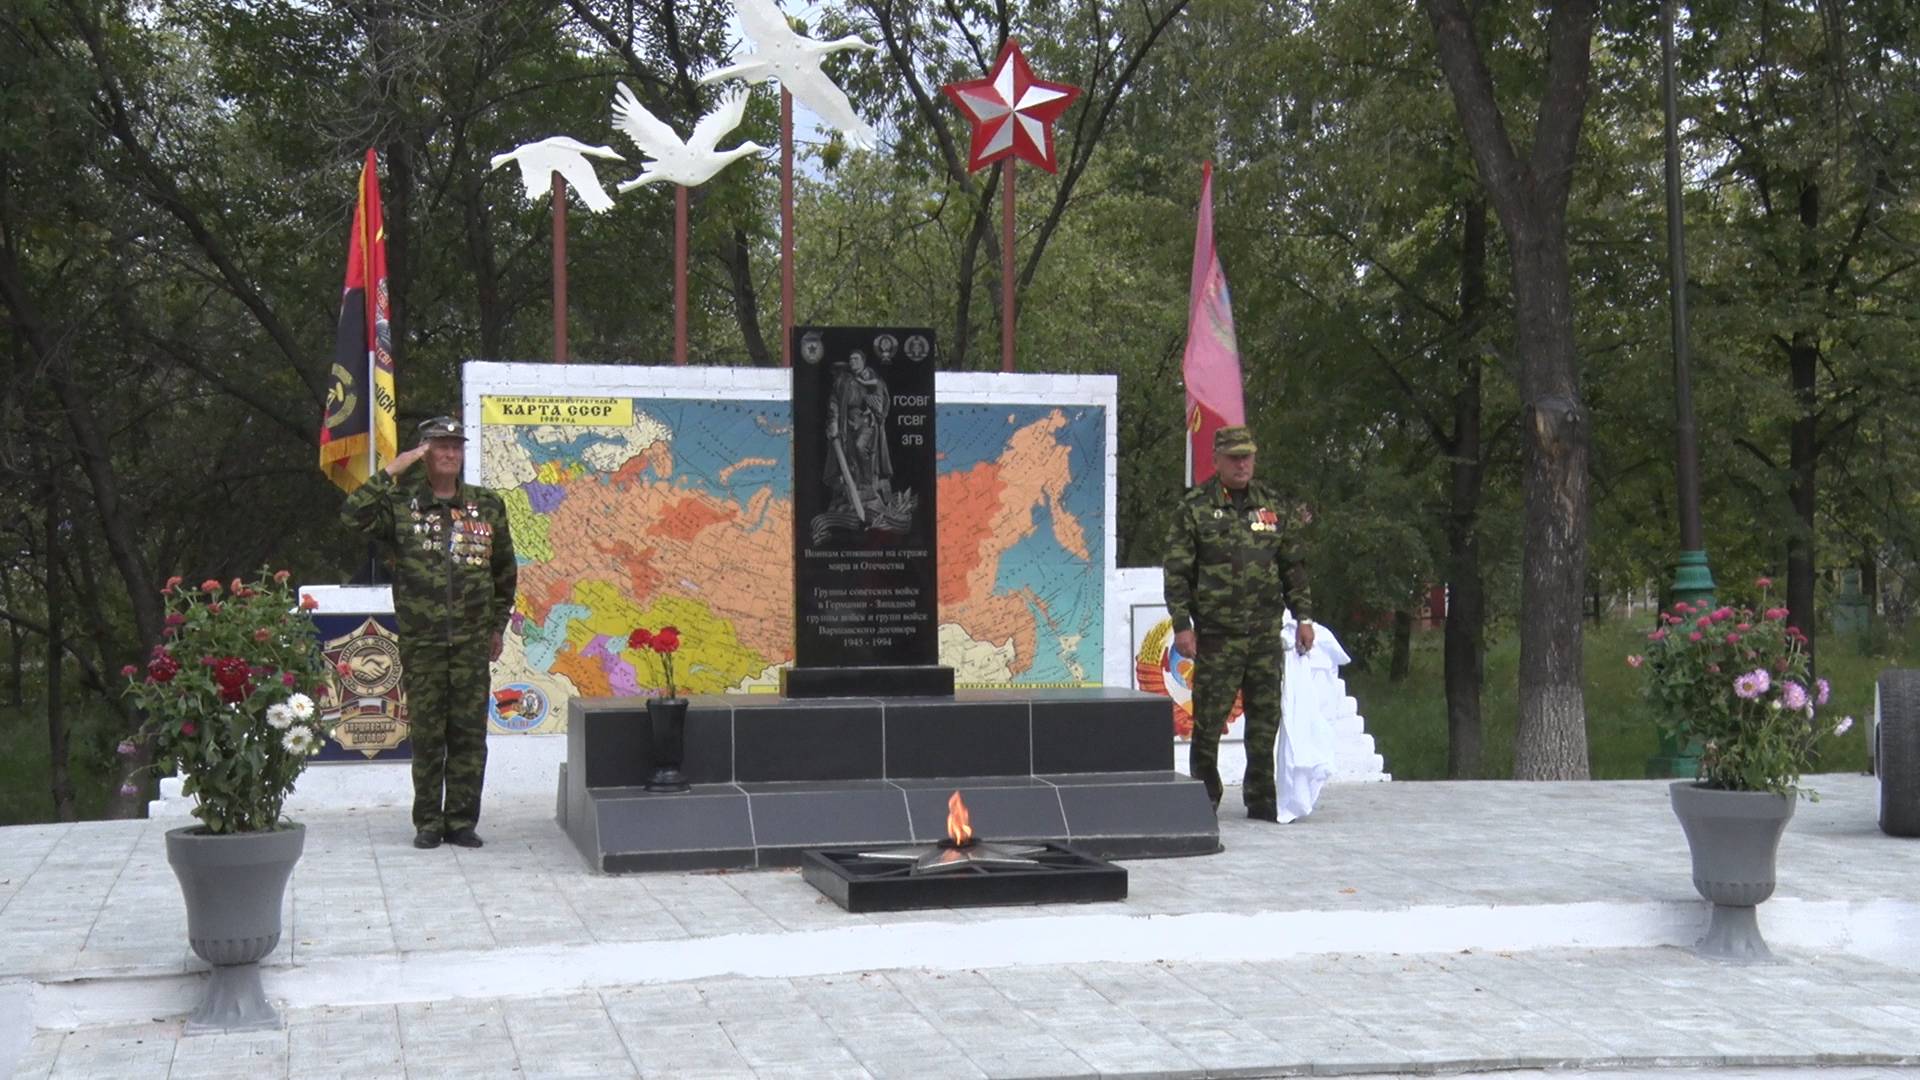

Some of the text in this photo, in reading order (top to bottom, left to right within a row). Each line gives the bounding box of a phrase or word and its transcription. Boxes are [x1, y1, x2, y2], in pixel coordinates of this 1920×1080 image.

[893, 395, 930, 406] ГСОВГ
[503, 404, 612, 416] КАРТА СССР
[897, 415, 926, 425] ГСВГ
[902, 434, 923, 445] ЗГВ
[860, 562, 905, 570] Отечества
[895, 587, 919, 596] войск
[825, 600, 867, 610] Германии
[819, 625, 916, 636] Варшавского договора
[843, 637, 863, 646] 1945
[872, 637, 892, 646] 1994
